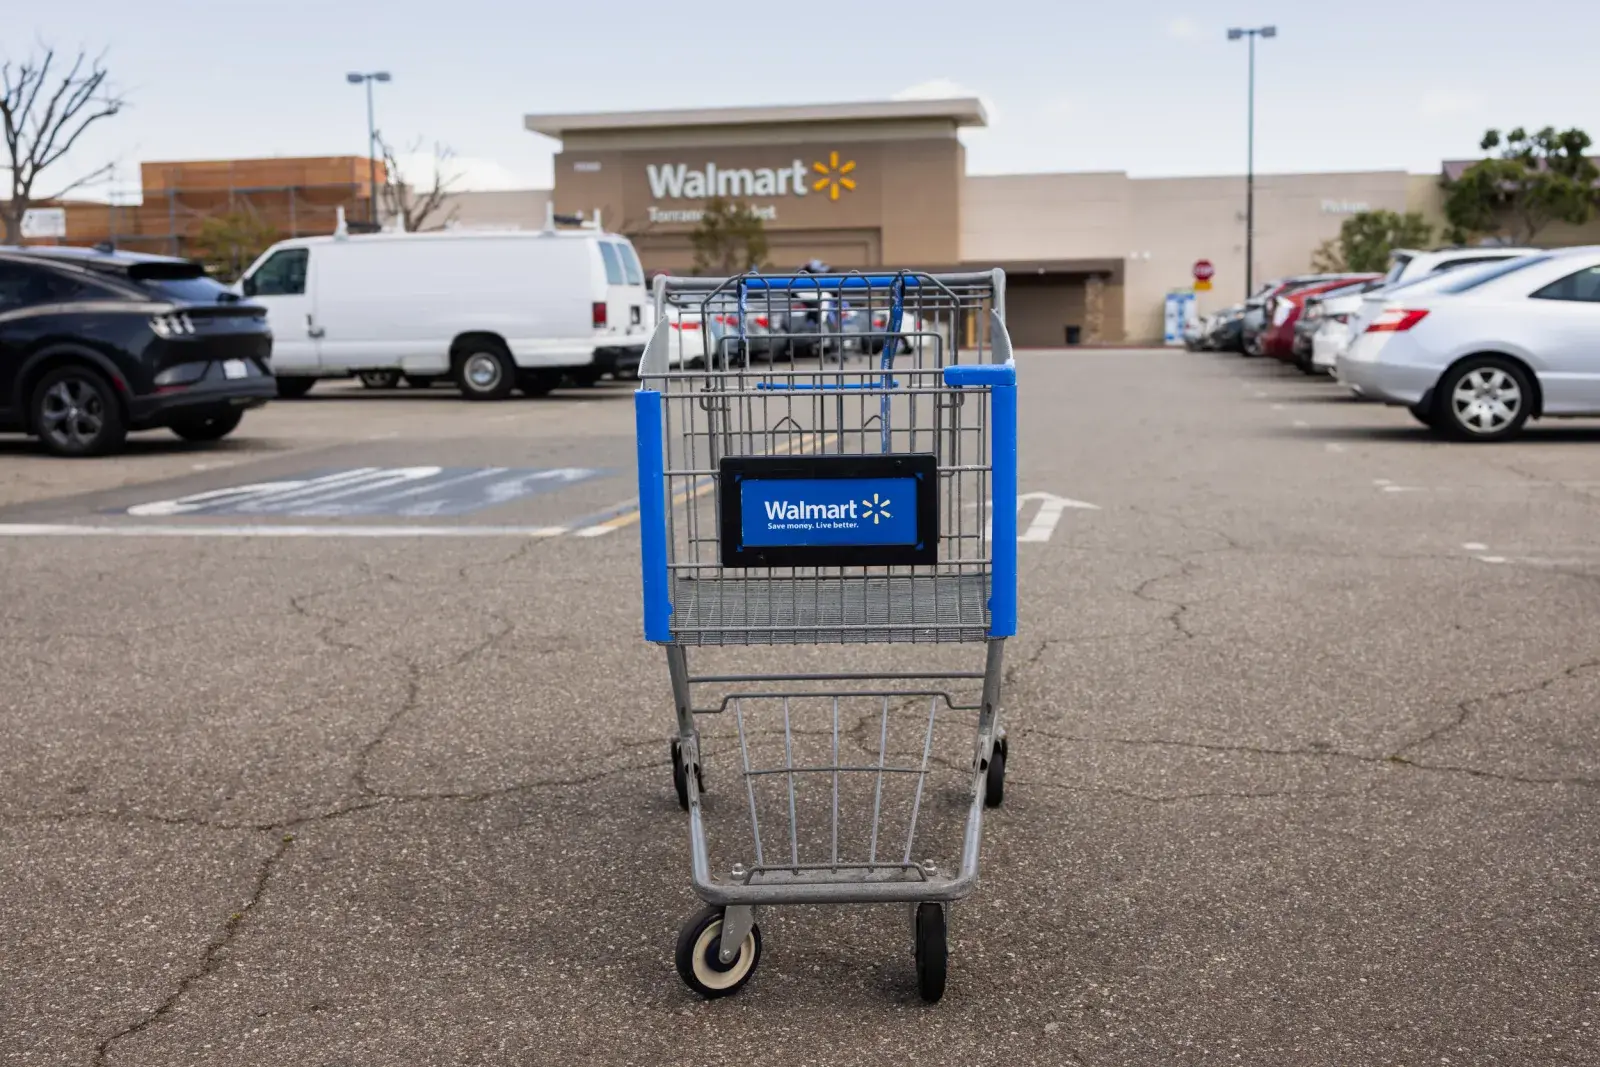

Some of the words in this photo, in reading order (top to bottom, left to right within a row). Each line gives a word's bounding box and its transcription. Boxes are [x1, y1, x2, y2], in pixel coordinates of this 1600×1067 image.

[646, 159, 808, 199] Walmart
[764, 500, 857, 520] Walmart
[767, 522, 786, 530] Save
[786, 523, 815, 531] money.
[815, 521, 833, 529] Live
[833, 521, 859, 529] better.
